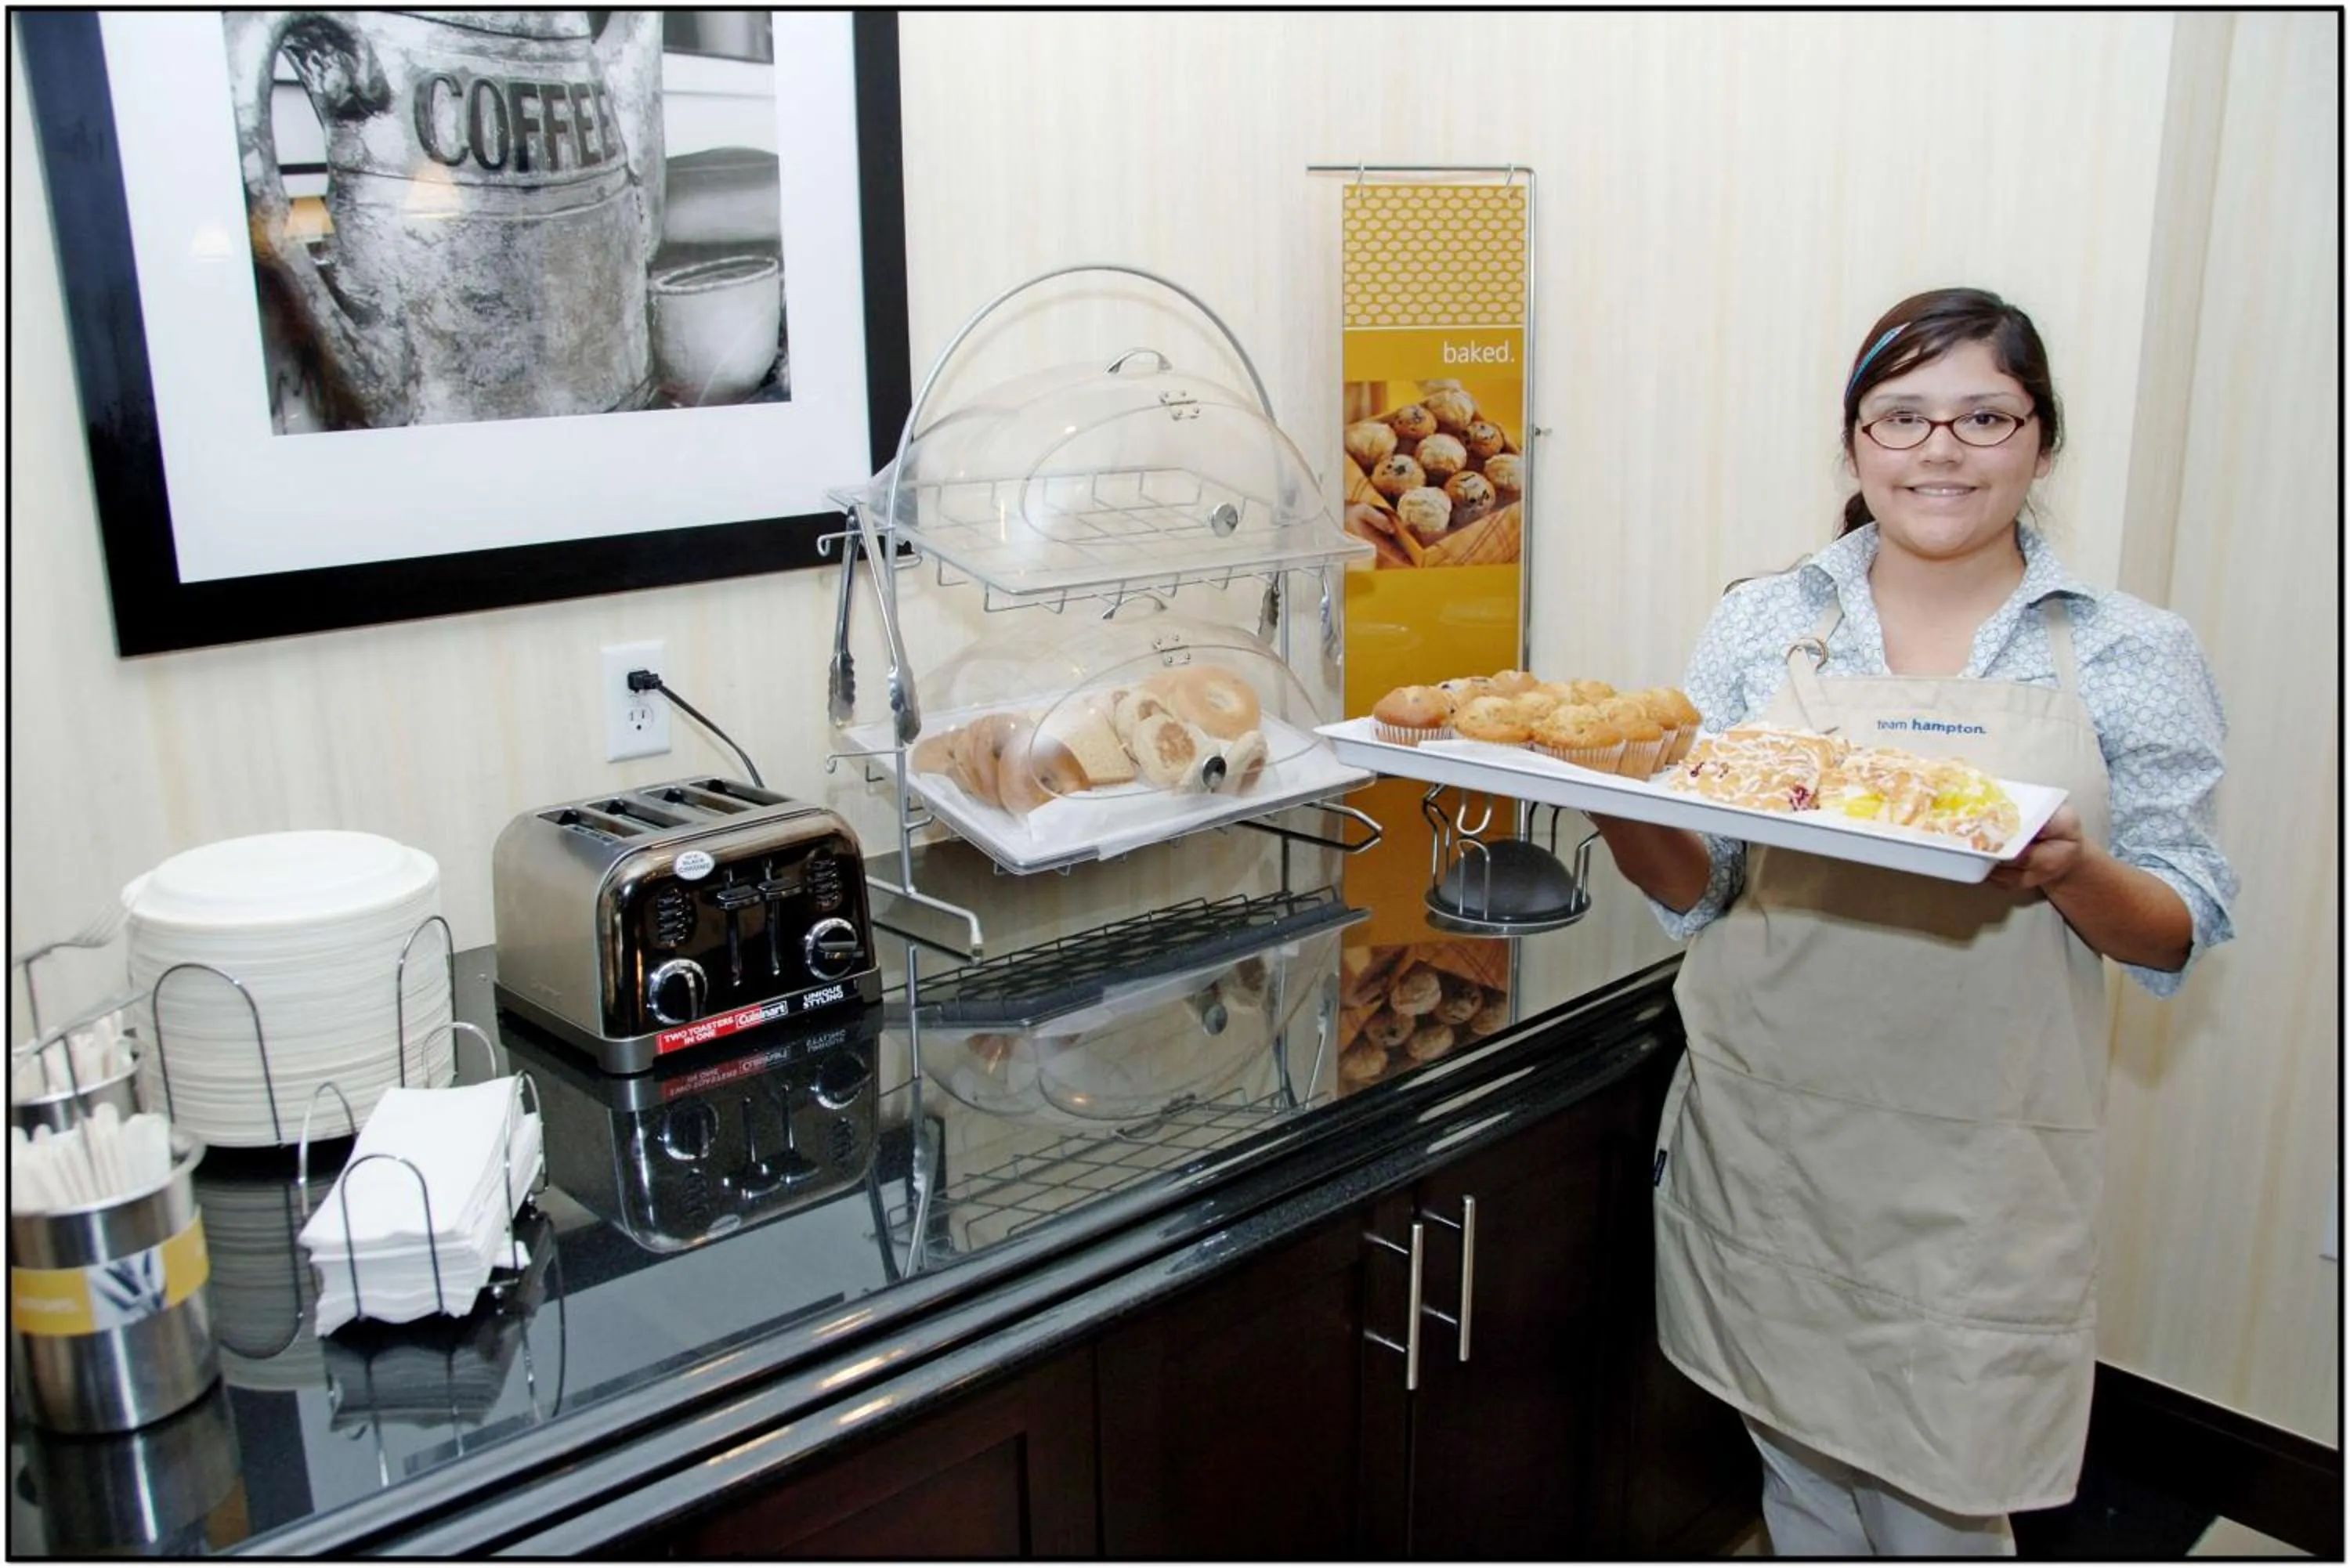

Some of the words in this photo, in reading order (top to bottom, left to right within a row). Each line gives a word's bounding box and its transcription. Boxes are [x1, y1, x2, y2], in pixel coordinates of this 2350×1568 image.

[414, 72, 619, 174] COFFEE
[1444, 339, 1515, 363] baked.
[1877, 719, 1907, 730] team
[1912, 718, 1987, 735] hampton.
[803, 985, 842, 1000] UNIQUE
[803, 991, 844, 1010] STYLING
[738, 1003, 785, 1025] Cuisinart
[664, 1030, 687, 1042] TWO
[688, 1016, 734, 1035] TOASTERS
[684, 1035, 695, 1045] IN
[696, 1028, 716, 1041] ONE
